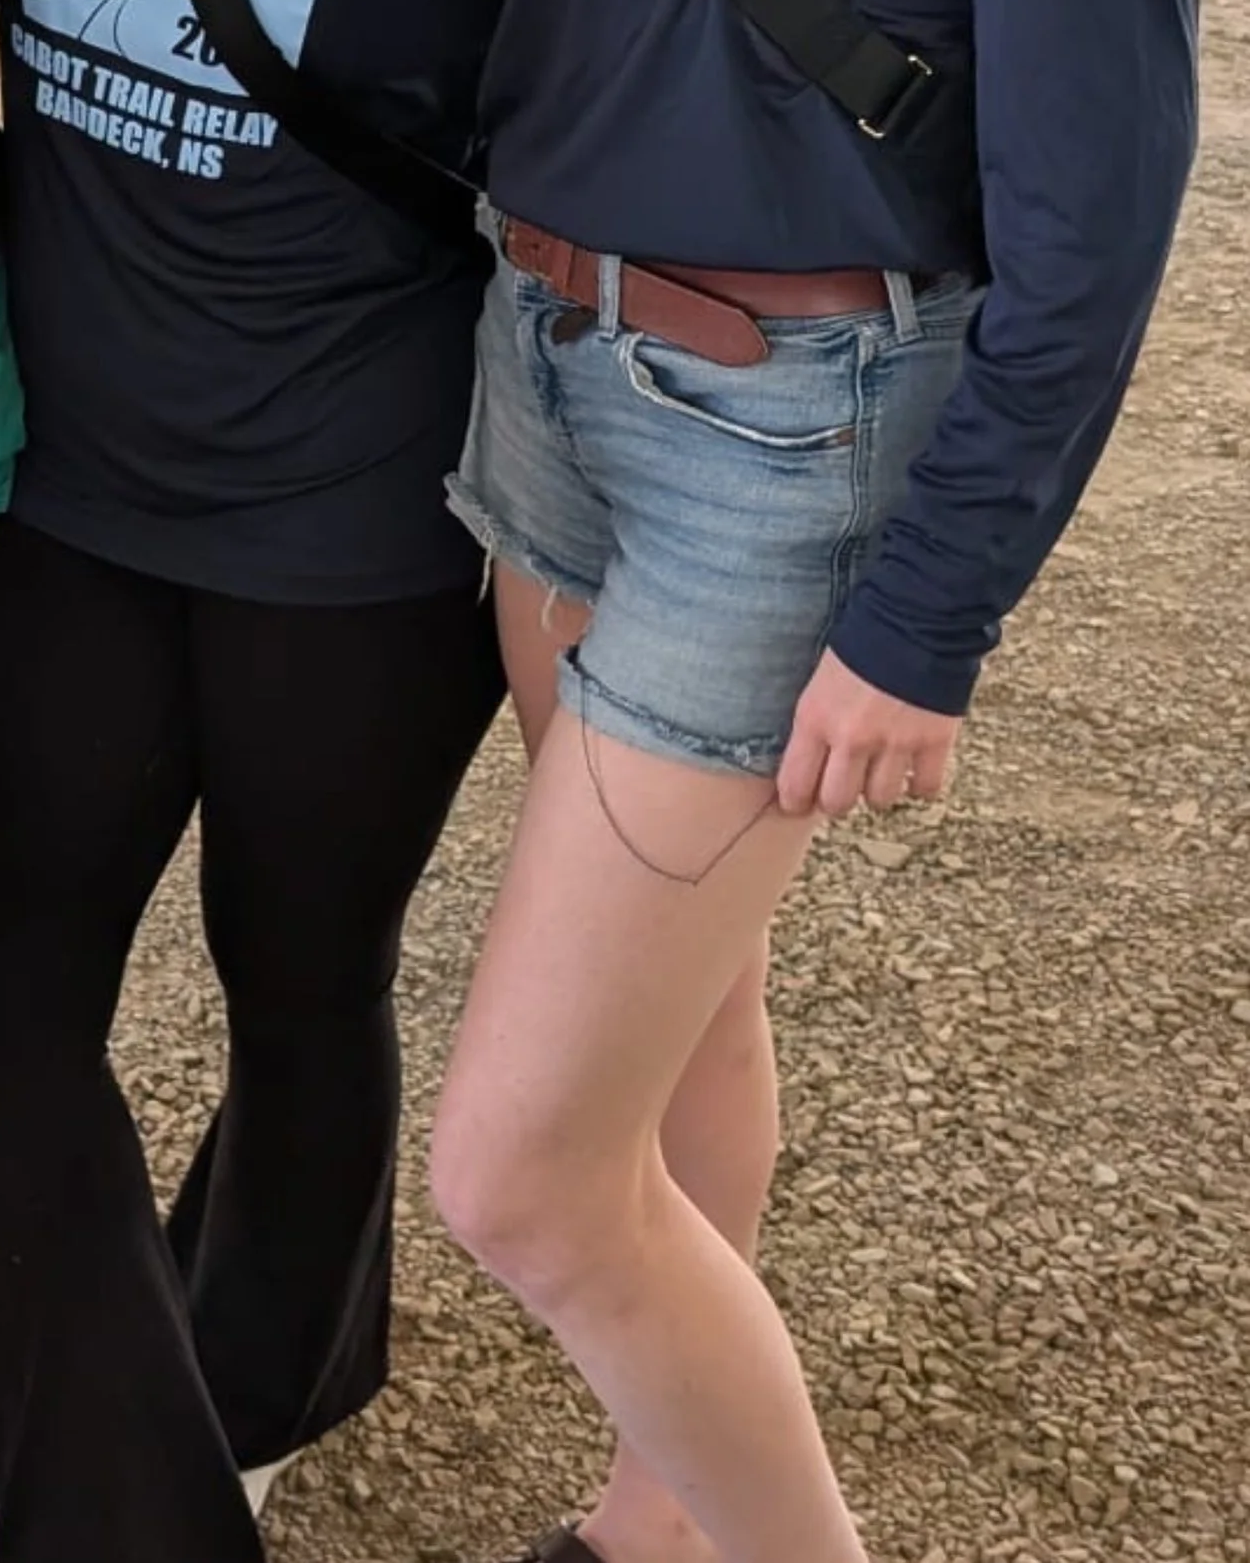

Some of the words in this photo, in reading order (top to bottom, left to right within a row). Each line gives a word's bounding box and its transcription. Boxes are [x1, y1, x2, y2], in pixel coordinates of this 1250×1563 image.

[11, 23, 89, 91] CABOT
[93, 66, 175, 128] TRAIL
[183, 99, 279, 148] RELAY
[171, 15, 220, 67] 20
[36, 79, 170, 169] BADDECK,
[177, 141, 225, 180] NS
